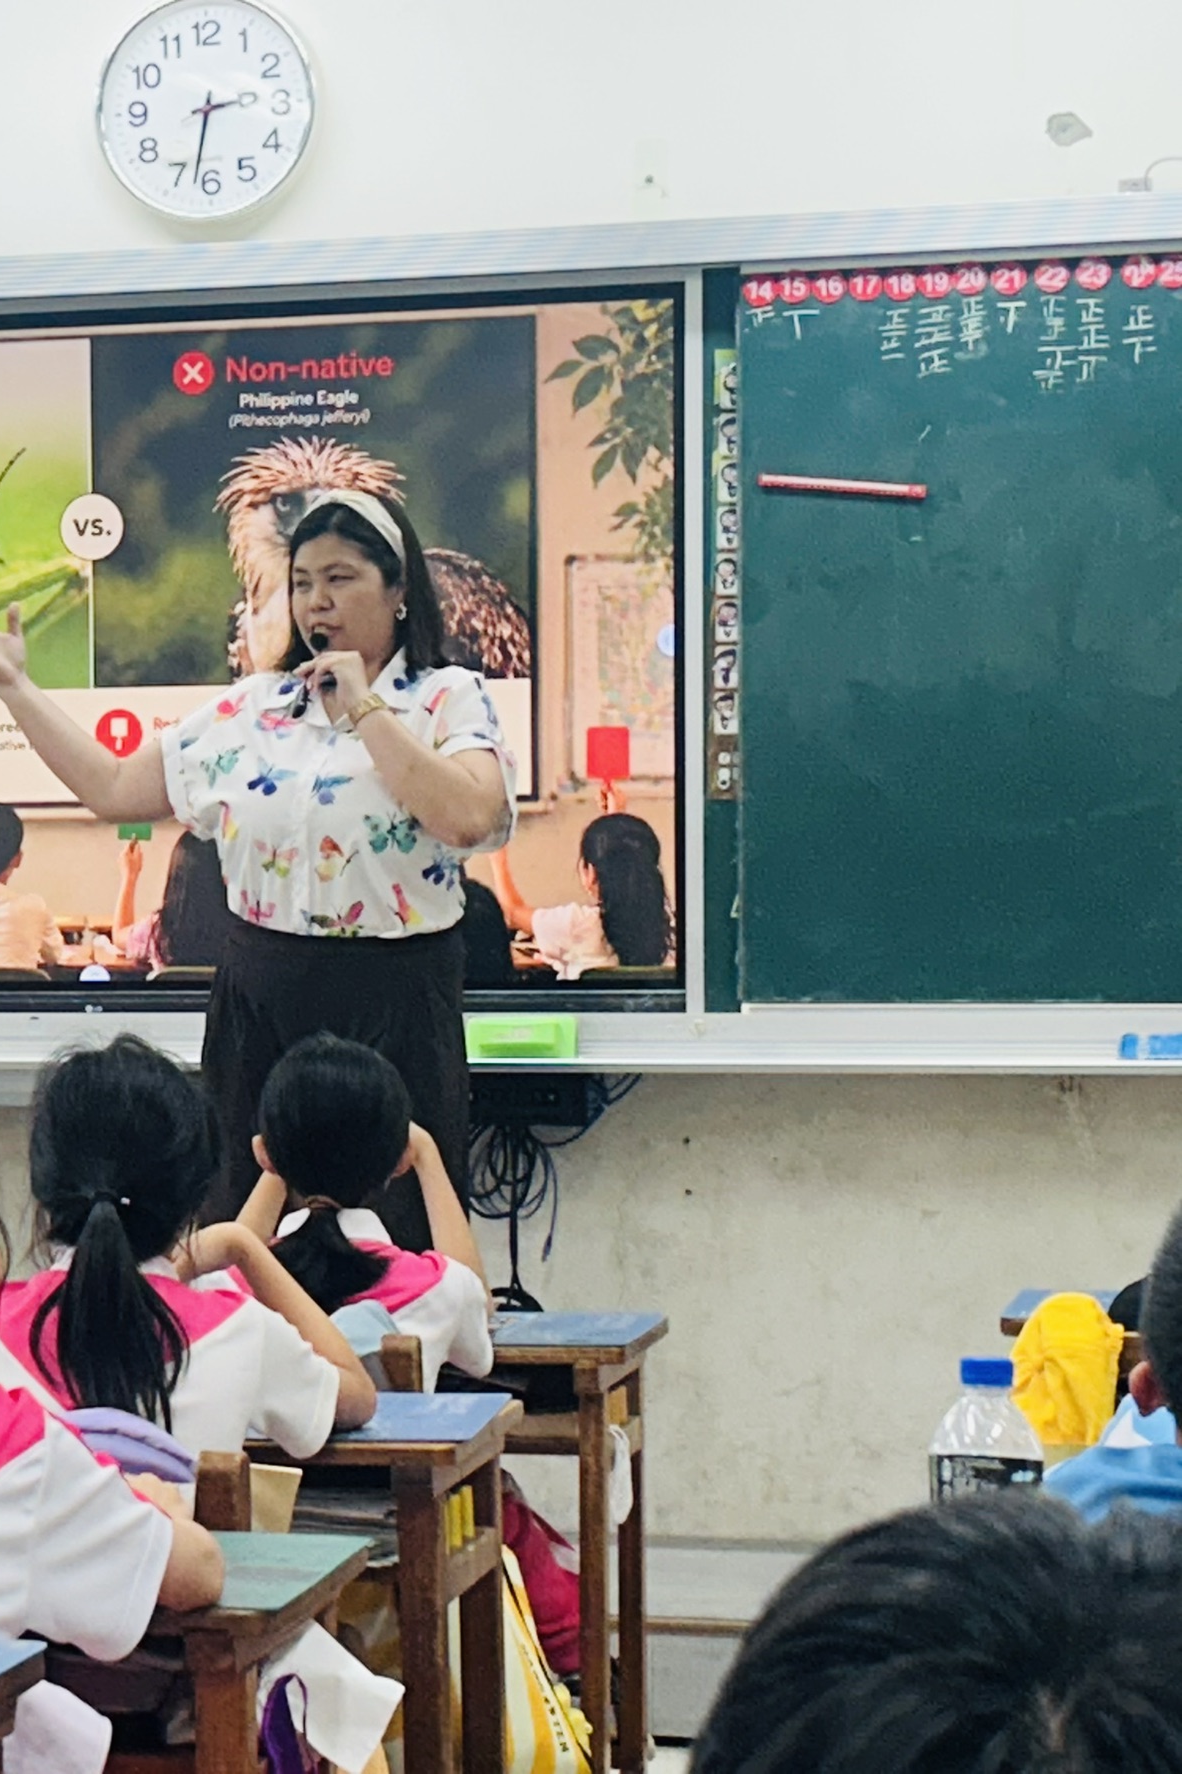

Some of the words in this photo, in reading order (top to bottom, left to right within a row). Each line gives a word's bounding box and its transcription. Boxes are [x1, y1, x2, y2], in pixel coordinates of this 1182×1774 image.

[192, 20, 221, 46] 12
[238, 28, 248, 52] 1
[159, 34, 181, 59] 11
[132, 63, 161, 90] 10
[260, 52, 281, 79] 2
[128, 101, 148, 127] 9
[271, 89, 291, 115] 3
[139, 137, 159, 163] 8
[262, 128, 282, 153] 4
[168, 162, 187, 188] 7
[201, 169, 221, 195] 6
[237, 156, 257, 182] 5
[747, 280, 775, 299] 14
[782, 277, 808, 296] 15
[816, 277, 843, 296] 16
[853, 275, 878, 293] 17
[889, 273, 915, 294] 18
[923, 271, 950, 291] 19
[956, 266, 984, 288] 20
[995, 267, 1021, 288] 21
[1037, 266, 1067, 287] 22
[1080, 261, 1108, 287] 23
[226, 351, 395, 383] Non-native
[239, 390, 315, 411] Philippine
[316, 389, 360, 408] Eagle
